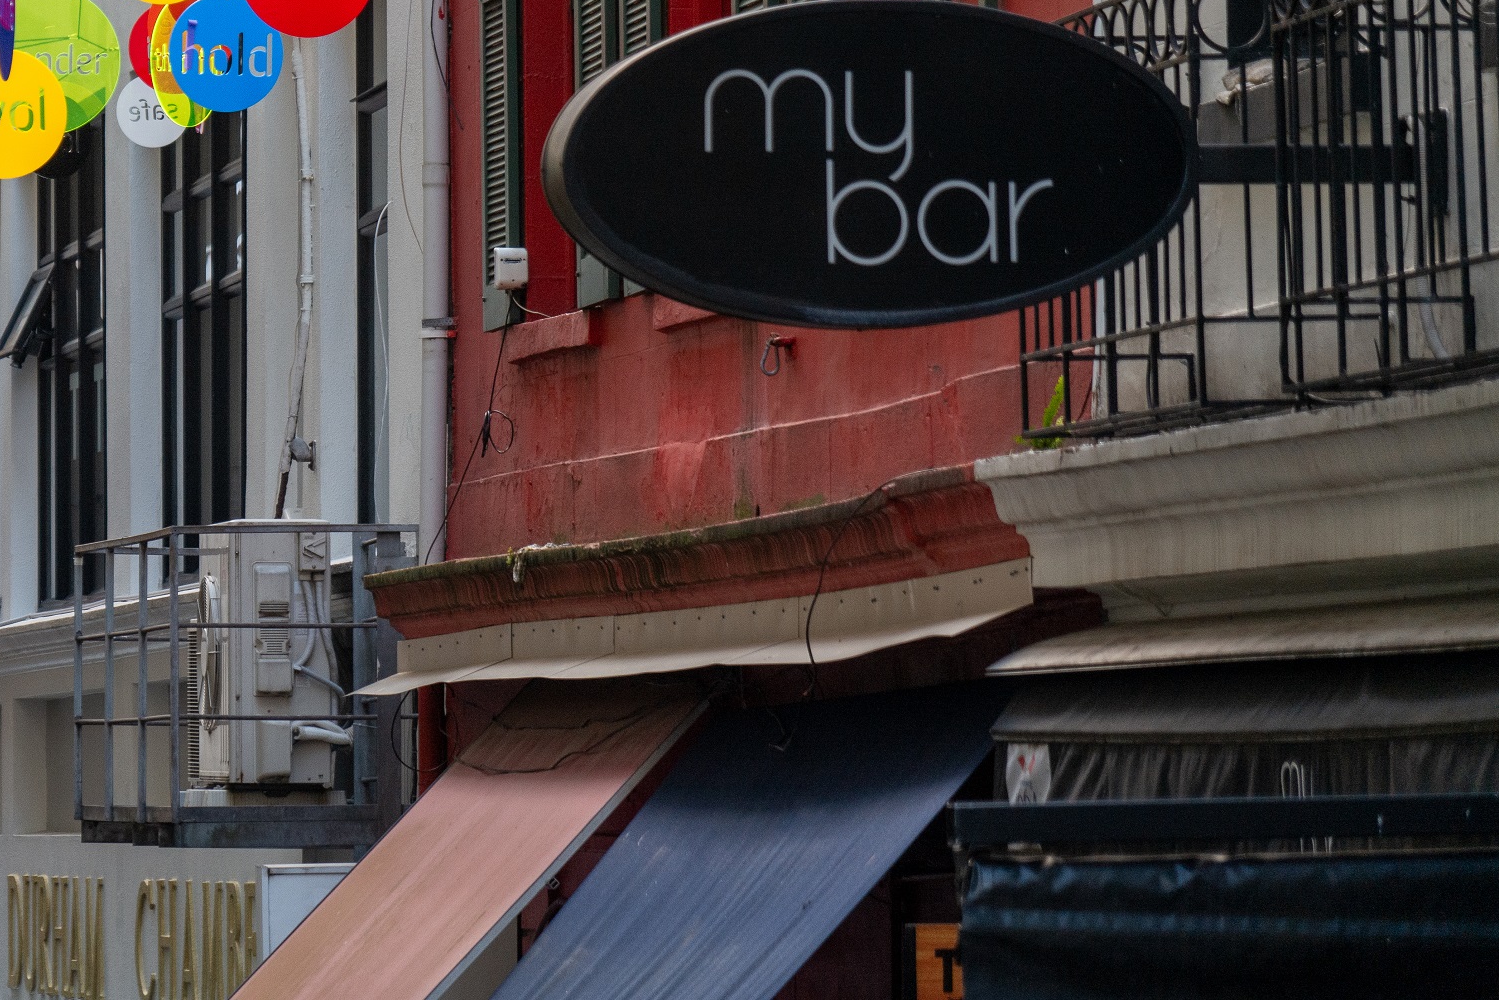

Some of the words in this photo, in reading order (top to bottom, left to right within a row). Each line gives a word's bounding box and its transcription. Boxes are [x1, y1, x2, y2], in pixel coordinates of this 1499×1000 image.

[181, 29, 273, 78] hold
[704, 68, 913, 182] my
[825, 158, 1053, 266] bar
